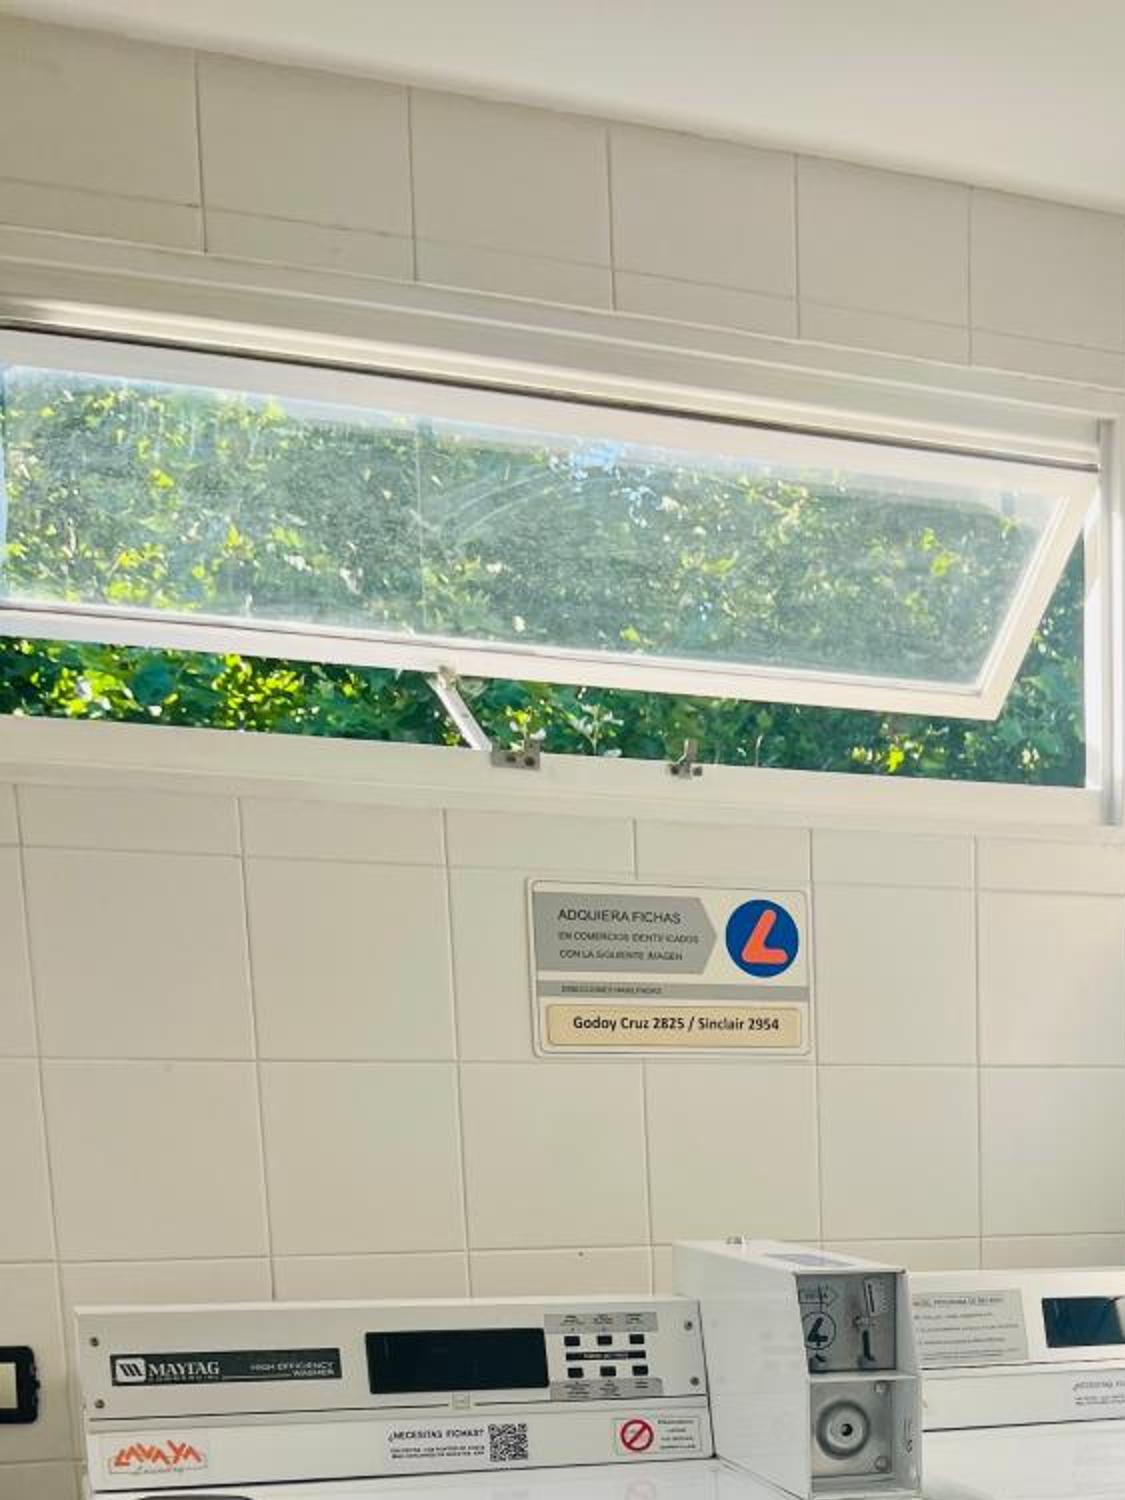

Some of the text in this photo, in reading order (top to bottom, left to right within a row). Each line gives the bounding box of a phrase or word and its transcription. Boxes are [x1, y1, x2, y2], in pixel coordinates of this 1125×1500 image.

[557, 908, 681, 925] ADQUIERA FICHAS
[574, 932, 630, 943] COMERCIOS
[632, 933, 699, 945] IDENTIFICADOS
[559, 950, 581, 960] CON
[582, 950, 594, 960] LA
[596, 950, 644, 961] SIGUIENTE
[573, 1016, 617, 1031] Godoy
[620, 1017, 650, 1030] Cruz
[653, 1017, 685, 1030] 2825
[698, 1017, 744, 1030] Sinclair
[748, 1018, 779, 1030] 2954
[149, 1361, 220, 1377] MAYTAG
[251, 1361, 335, 1371] HIGH EFFICIENCY
